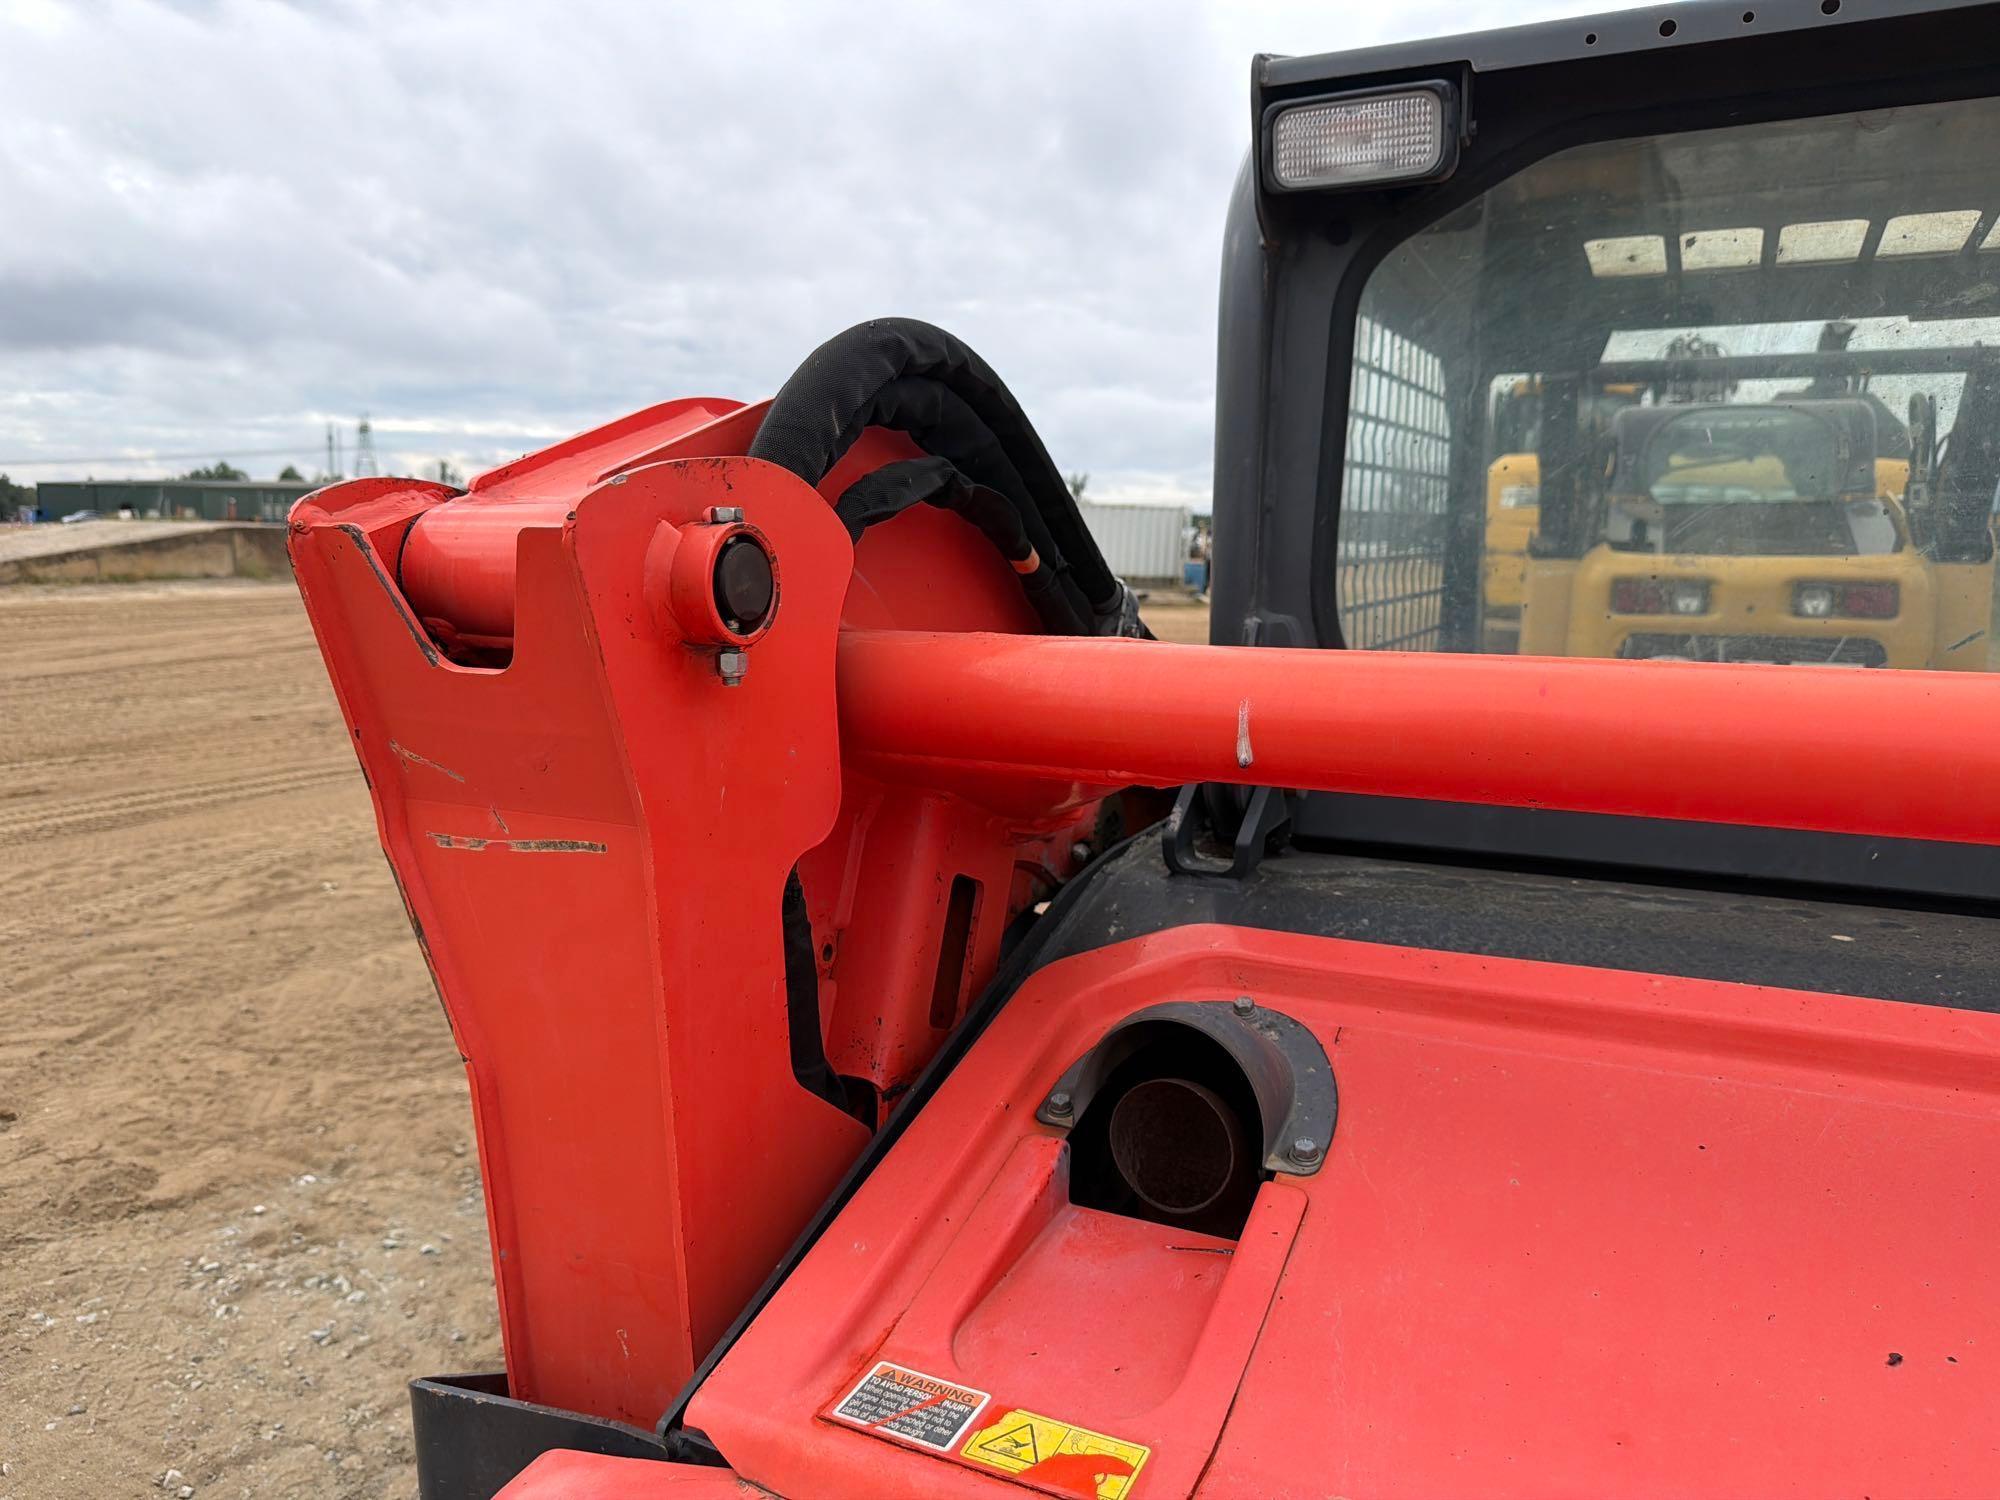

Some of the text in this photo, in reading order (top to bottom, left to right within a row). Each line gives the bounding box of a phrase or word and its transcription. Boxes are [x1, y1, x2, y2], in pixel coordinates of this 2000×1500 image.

[861, 1383, 884, 1394] When
[880, 1391, 910, 1404] opening
[946, 1410, 960, 1419] the
[867, 1376, 882, 1384] TO
[879, 1380, 905, 1392] AVOID
[902, 1387, 944, 1404] PERSON
[901, 1373, 974, 1403] WARNING
[839, 1405, 861, 1417] parts
[881, 1419, 901, 1431] ody
[846, 1398, 862, 1407] get
[858, 1403, 877, 1412] your
[931, 1425, 953, 1436] other
[853, 1392, 879, 1404] engine
[909, 1408, 933, 1419] areful
[930, 1415, 944, 1423] not
